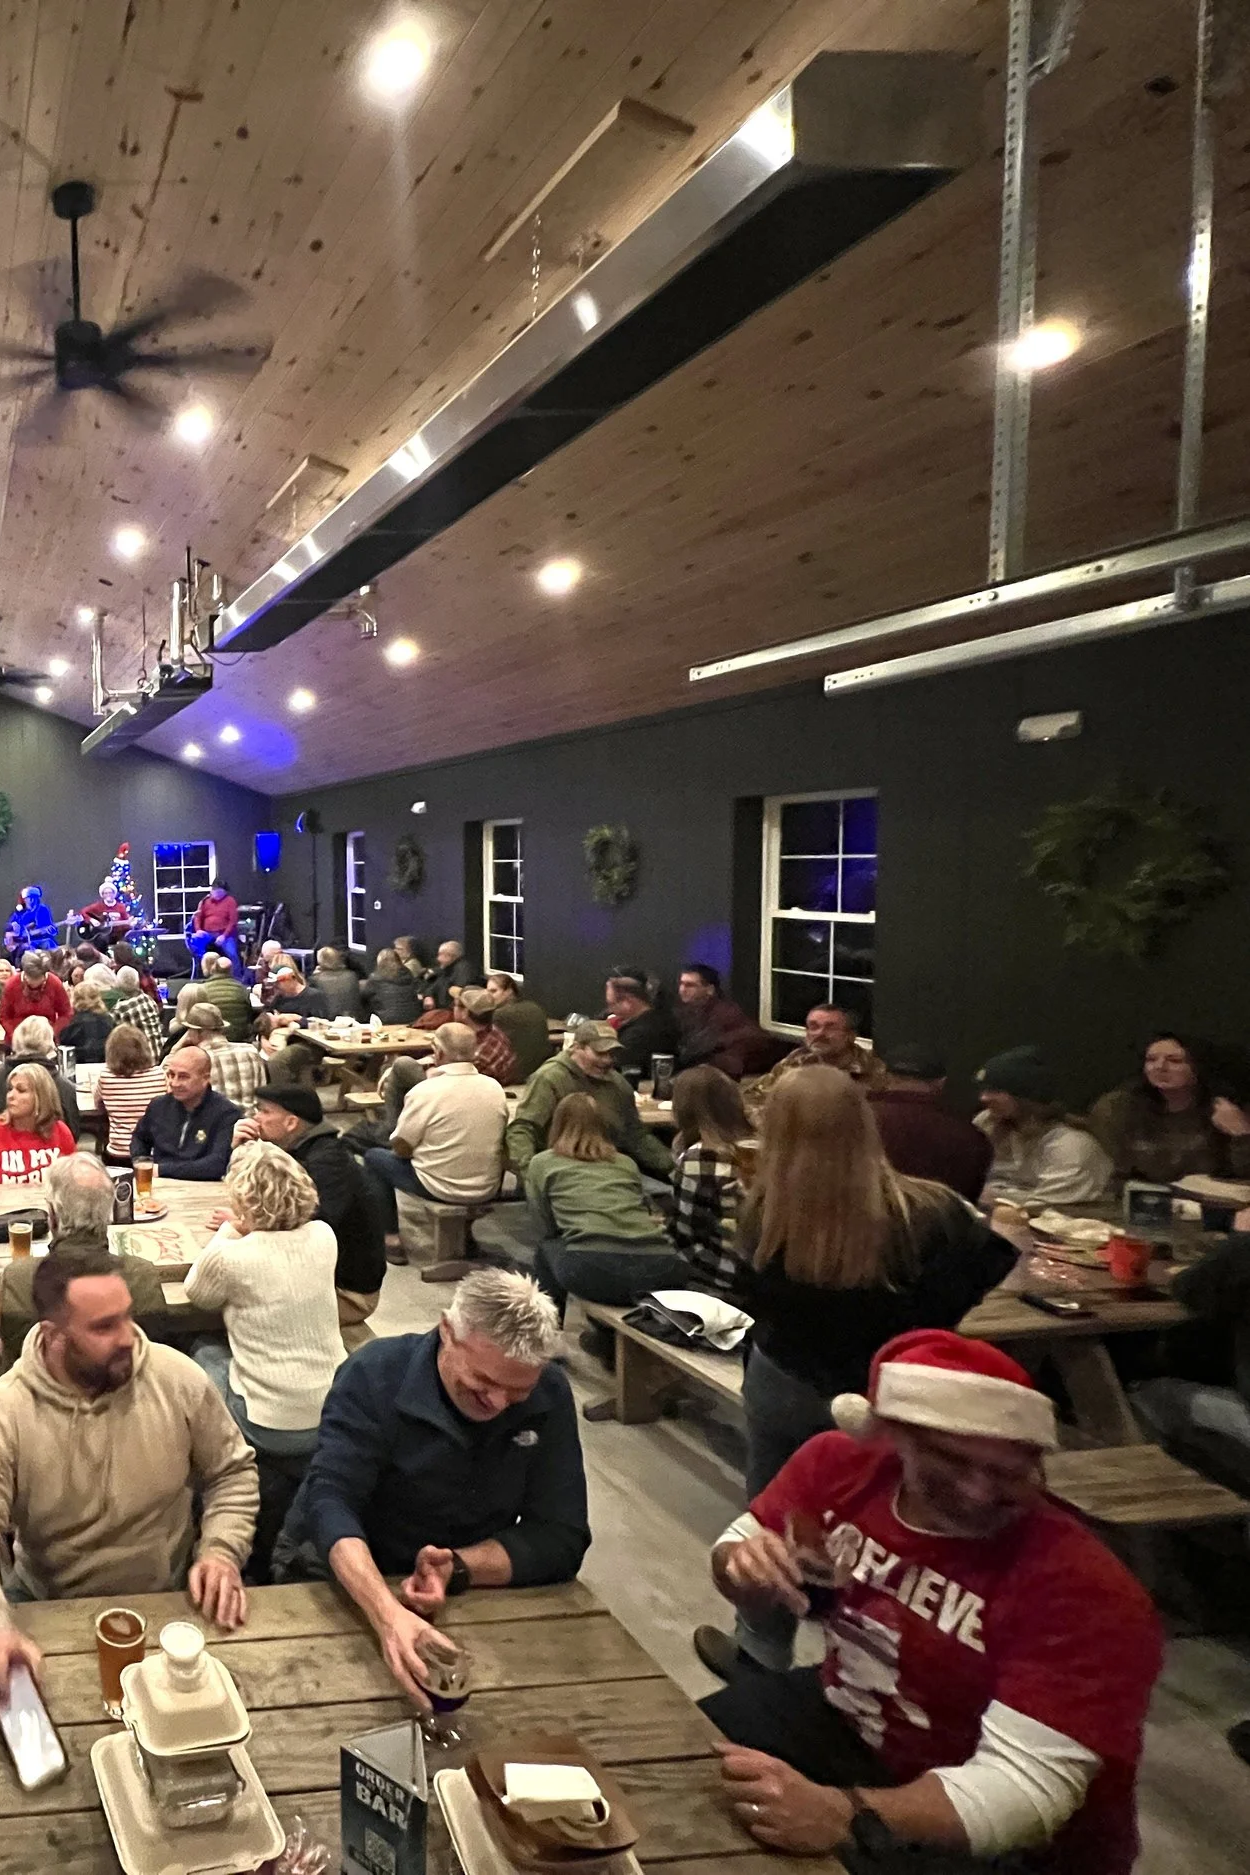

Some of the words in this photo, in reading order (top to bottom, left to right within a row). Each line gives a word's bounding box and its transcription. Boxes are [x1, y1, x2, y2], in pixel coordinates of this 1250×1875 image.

[1, 1150, 25, 1173] IN
[29, 1147, 60, 1169] MY
[355, 1761, 405, 1804] ORDER
[355, 1781, 409, 1830] BAR
